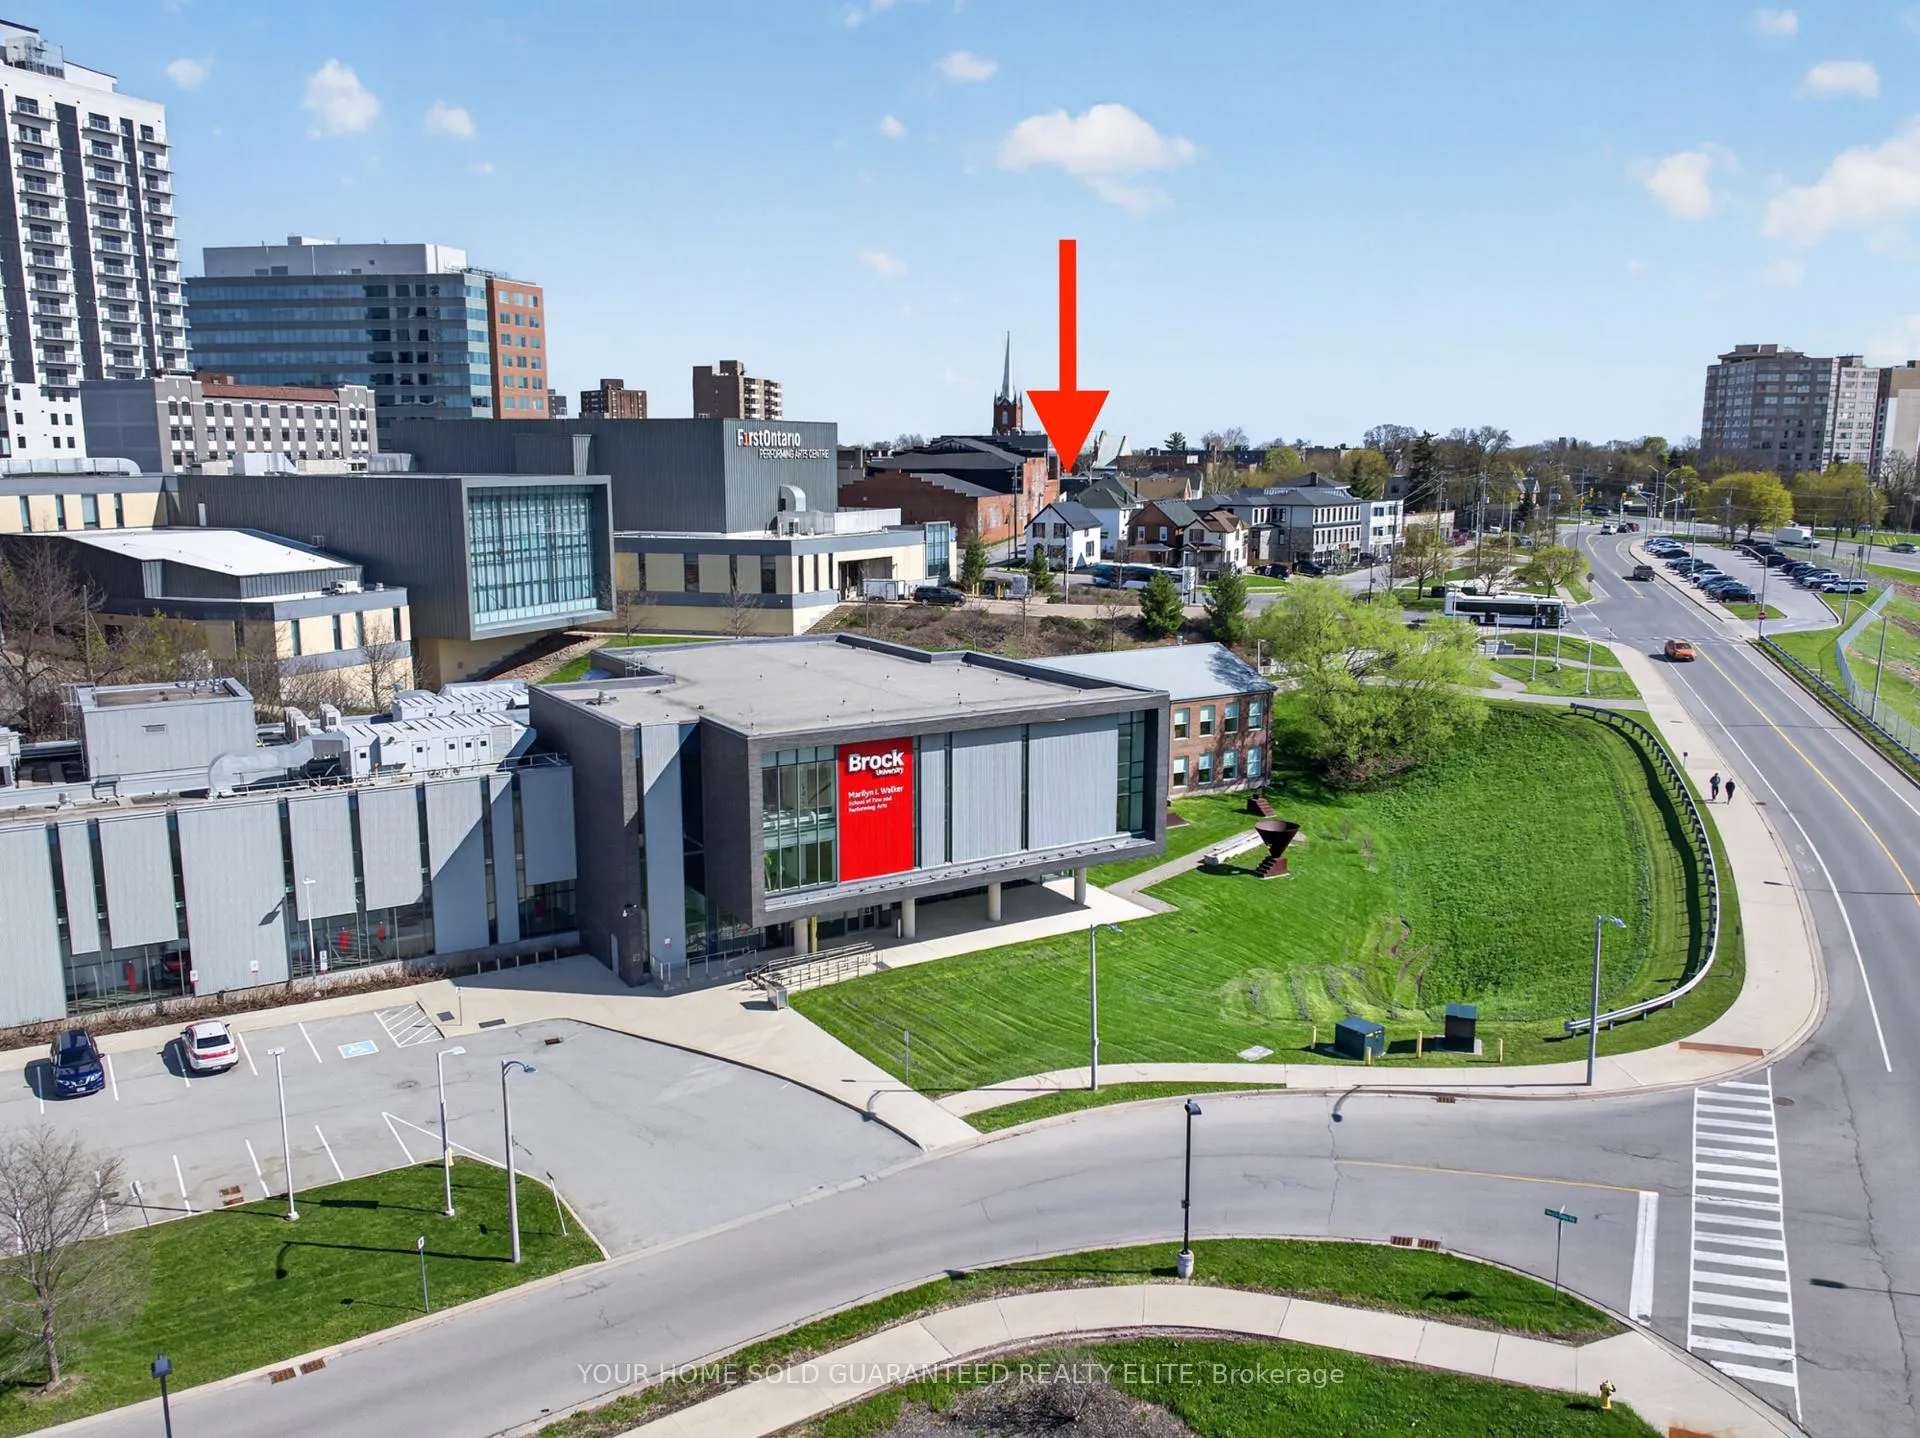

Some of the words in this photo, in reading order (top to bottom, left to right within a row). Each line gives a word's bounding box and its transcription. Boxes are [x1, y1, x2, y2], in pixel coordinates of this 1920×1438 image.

[737, 429, 801, 448] FirstOntario
[760, 448, 794, 459] PERFORMING
[795, 448, 808, 459] ARTS
[809, 449, 830, 459] CENTRE
[848, 749, 905, 772] Brock
[875, 767, 904, 776] University
[848, 789, 874, 799] Marilyn
[881, 786, 904, 795] Walker
[848, 805, 876, 813] Performing
